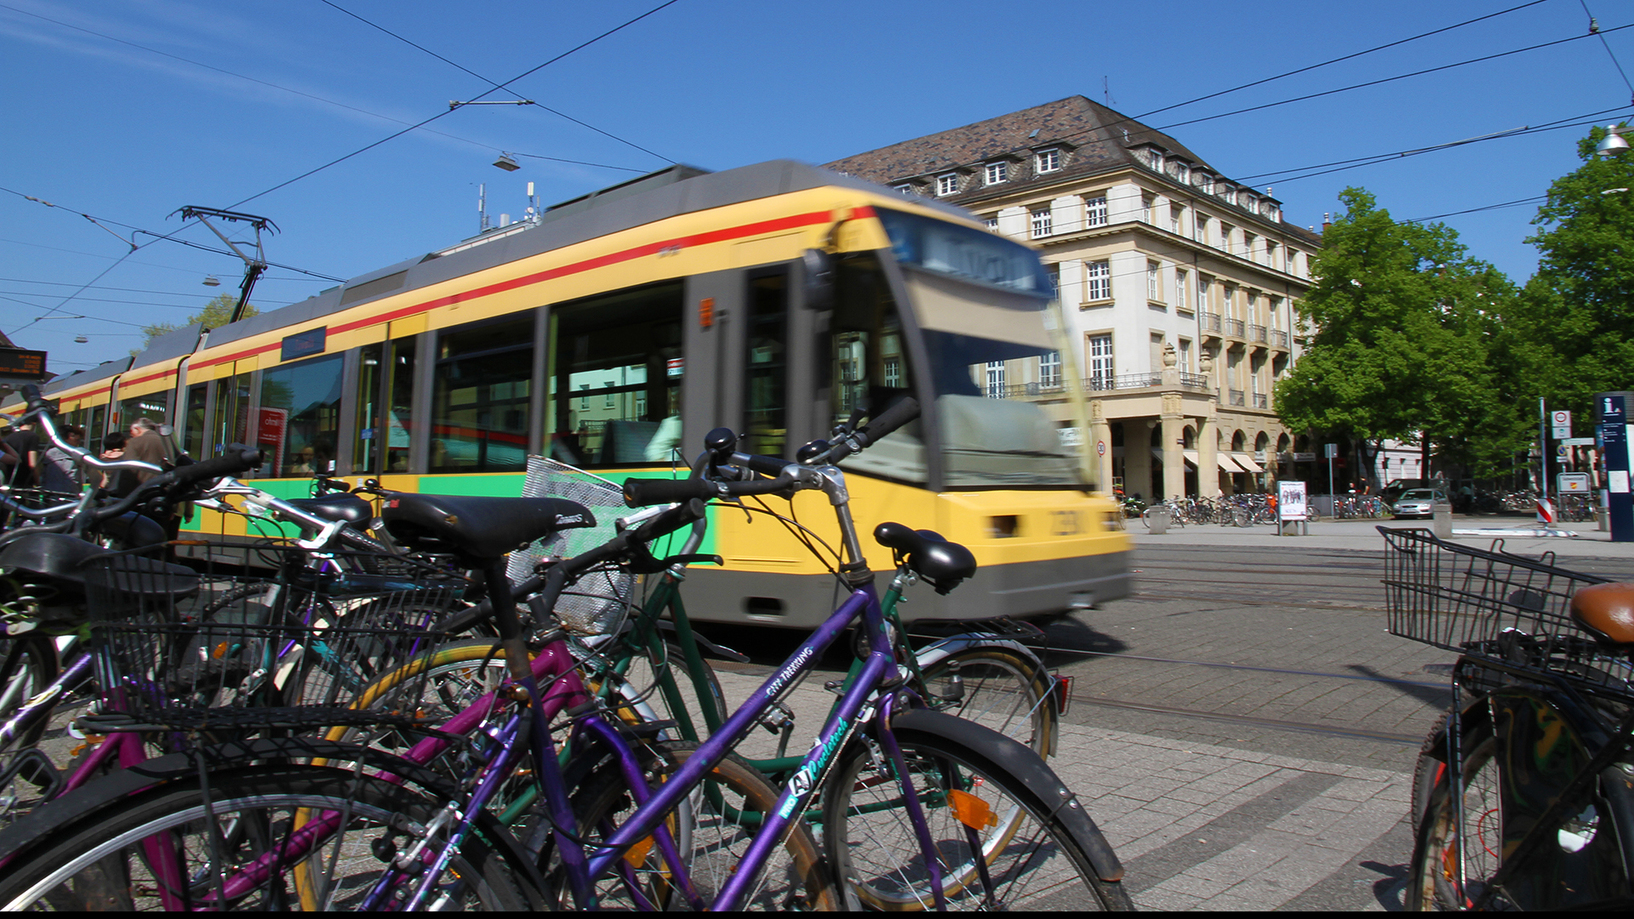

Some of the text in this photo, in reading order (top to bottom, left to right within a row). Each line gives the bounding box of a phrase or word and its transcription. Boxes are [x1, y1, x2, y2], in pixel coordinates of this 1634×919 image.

[765, 646, 814, 697] CITY TREKKING
[780, 798, 797, 818] PRO
[805, 716, 848, 781] Cycletech
